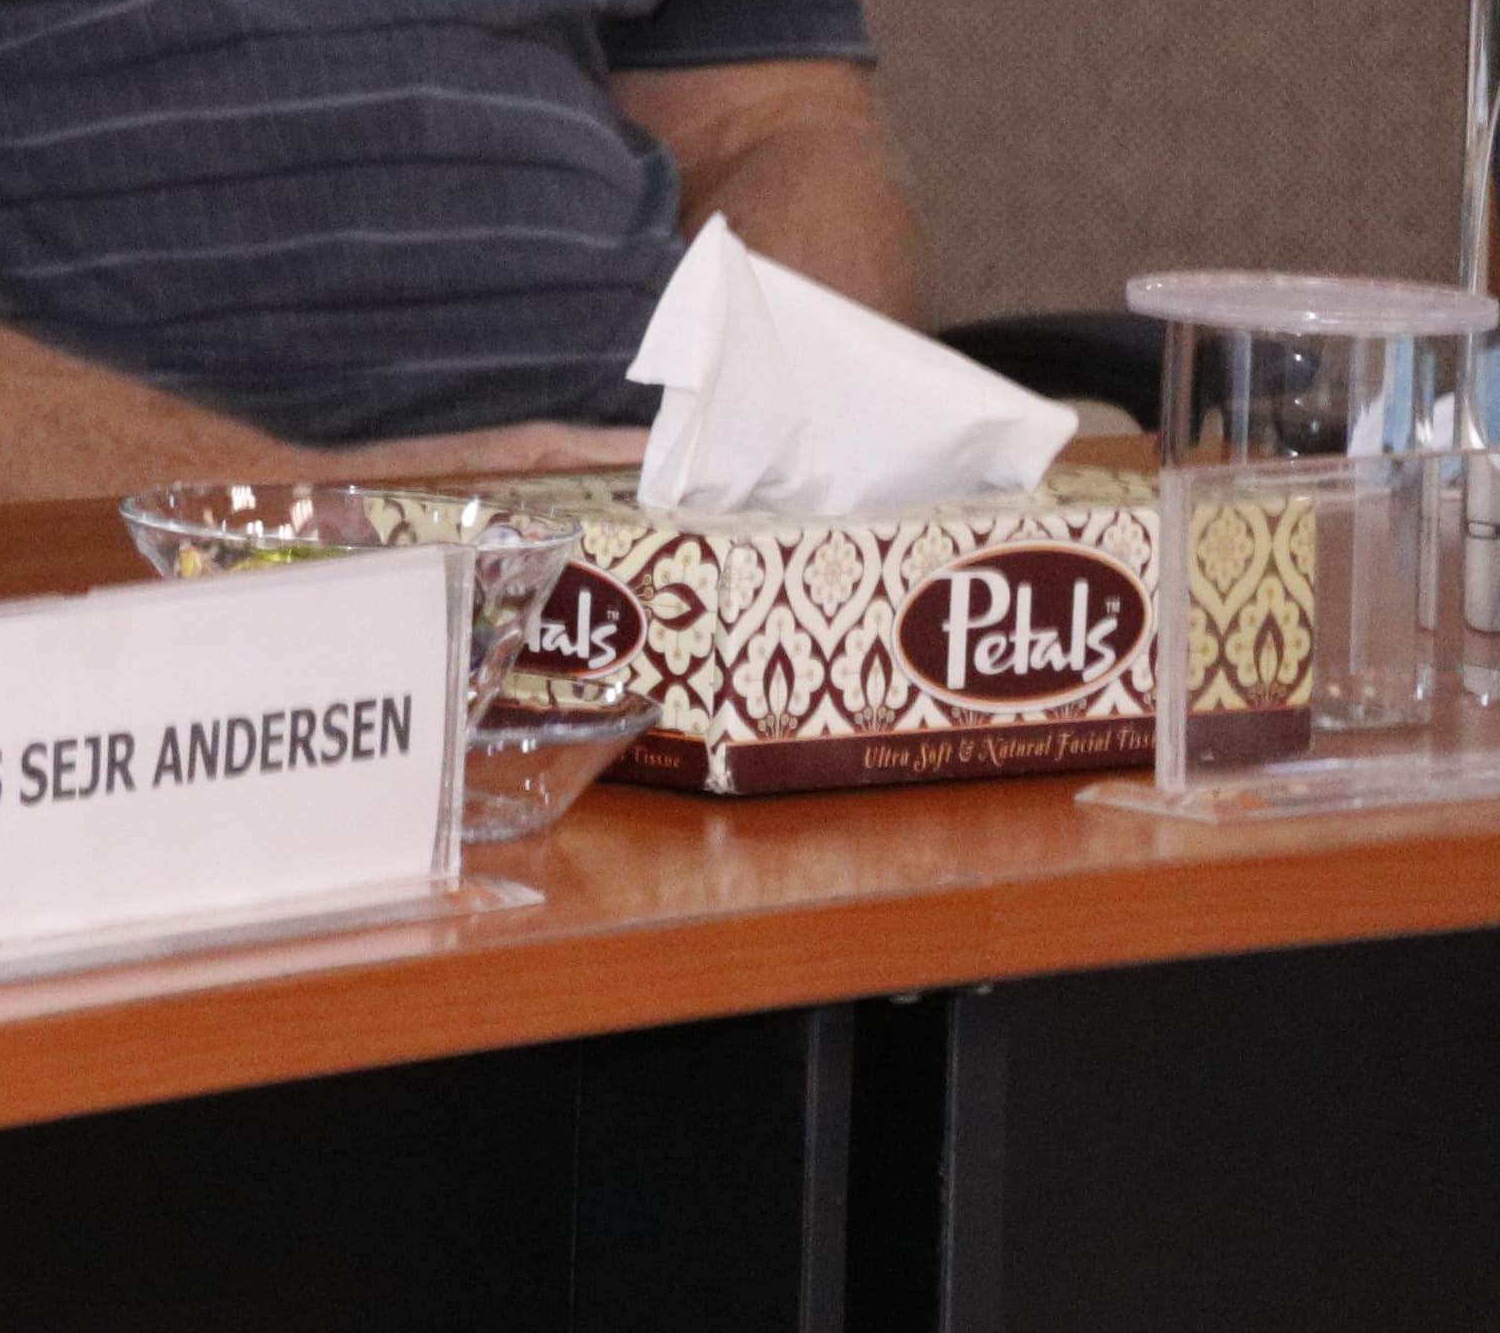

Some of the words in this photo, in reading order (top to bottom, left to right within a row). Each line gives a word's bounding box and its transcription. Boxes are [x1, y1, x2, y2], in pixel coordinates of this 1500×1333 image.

[942, 567, 1118, 690] Petals
[18, 730, 137, 808] SEJR
[151, 693, 413, 789] ANDERSEN
[864, 744, 910, 769] Ultra
[913, 740, 952, 772] Soft
[978, 732, 1052, 768] Natural
[1053, 728, 1111, 762] Facial
